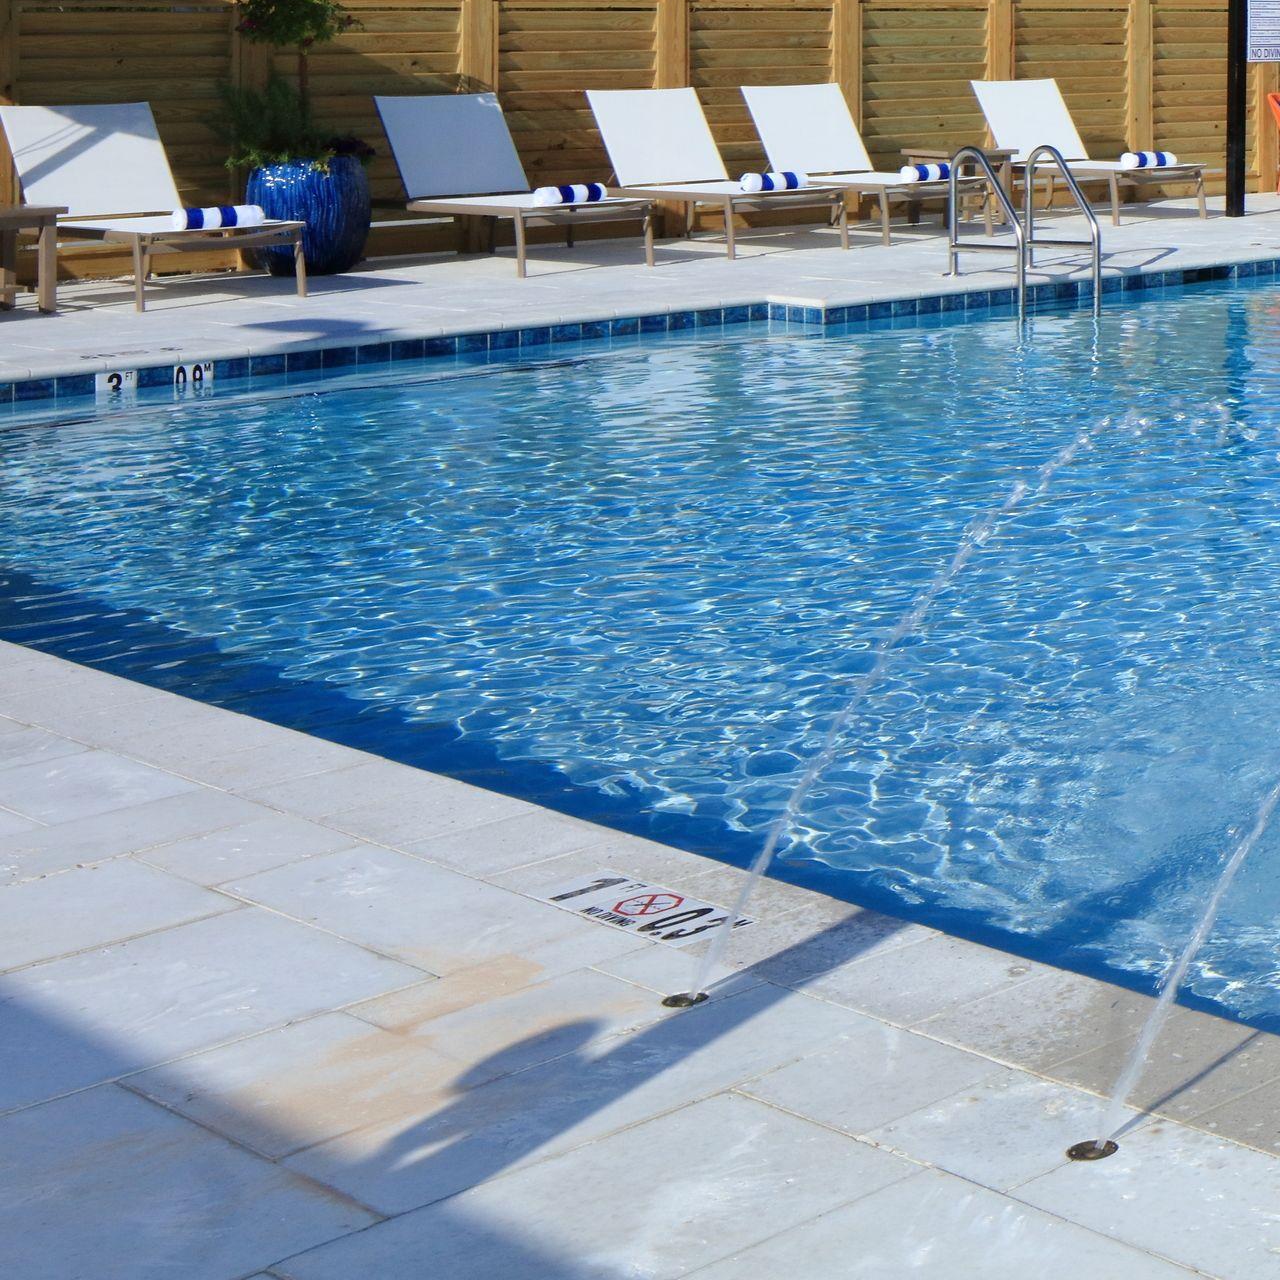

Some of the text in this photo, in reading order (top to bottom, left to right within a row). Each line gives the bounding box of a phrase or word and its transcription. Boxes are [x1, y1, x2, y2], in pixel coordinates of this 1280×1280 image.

[1251, 48, 1262, 58] NO
[203, 363, 212, 373] M
[125, 371, 134, 381] FT
[549, 877, 630, 902] 1
[579, 906, 636, 926] NO DIVING
